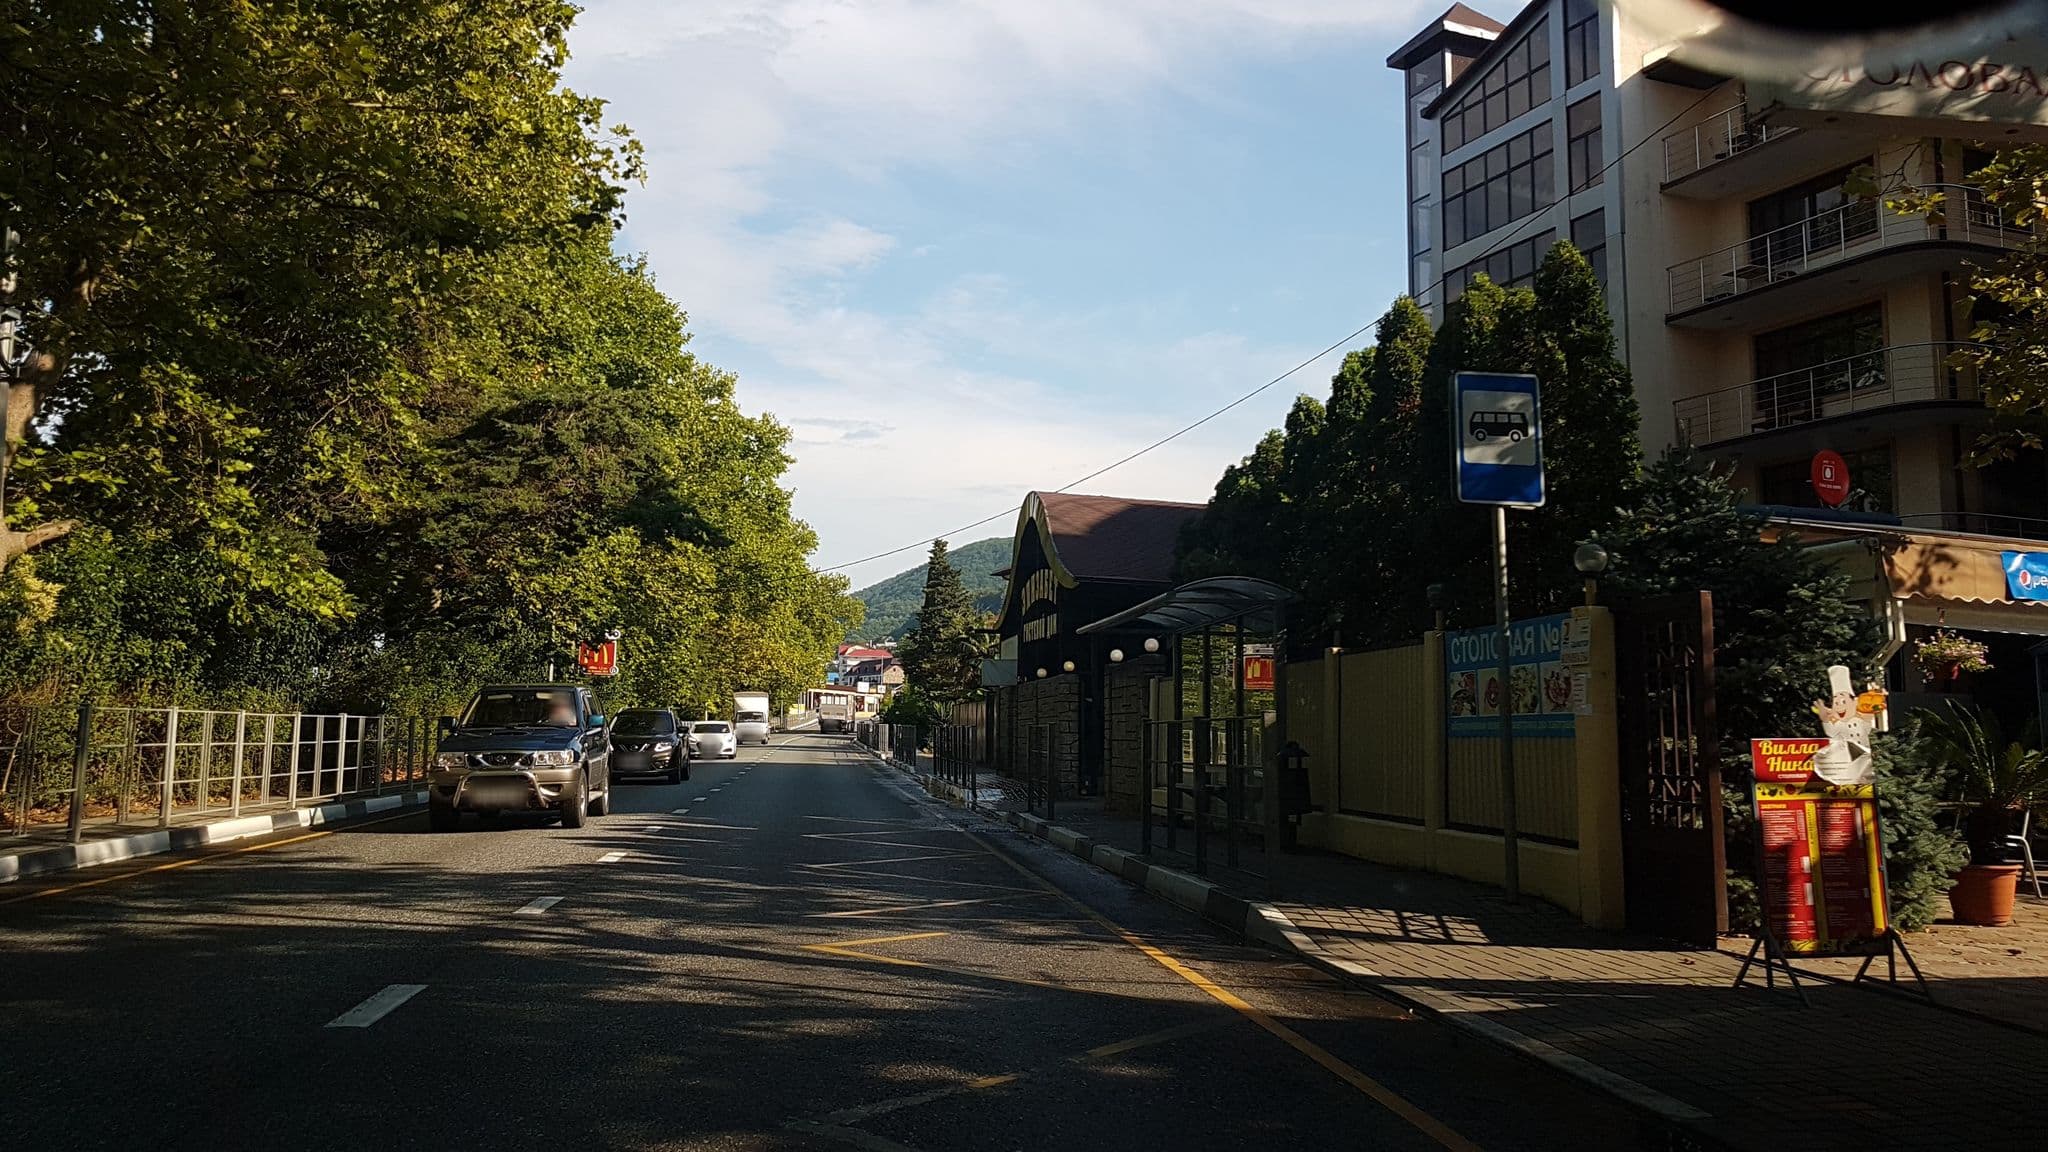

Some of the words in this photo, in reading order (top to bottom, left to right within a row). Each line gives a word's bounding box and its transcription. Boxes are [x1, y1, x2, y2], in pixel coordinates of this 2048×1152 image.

[2032, 573, 2048, 589] pe
[1451, 626, 1535, 665] СТОЛОАЯ
[1758, 740, 1820, 756] Вилла
[1766, 756, 1816, 772] Ника
